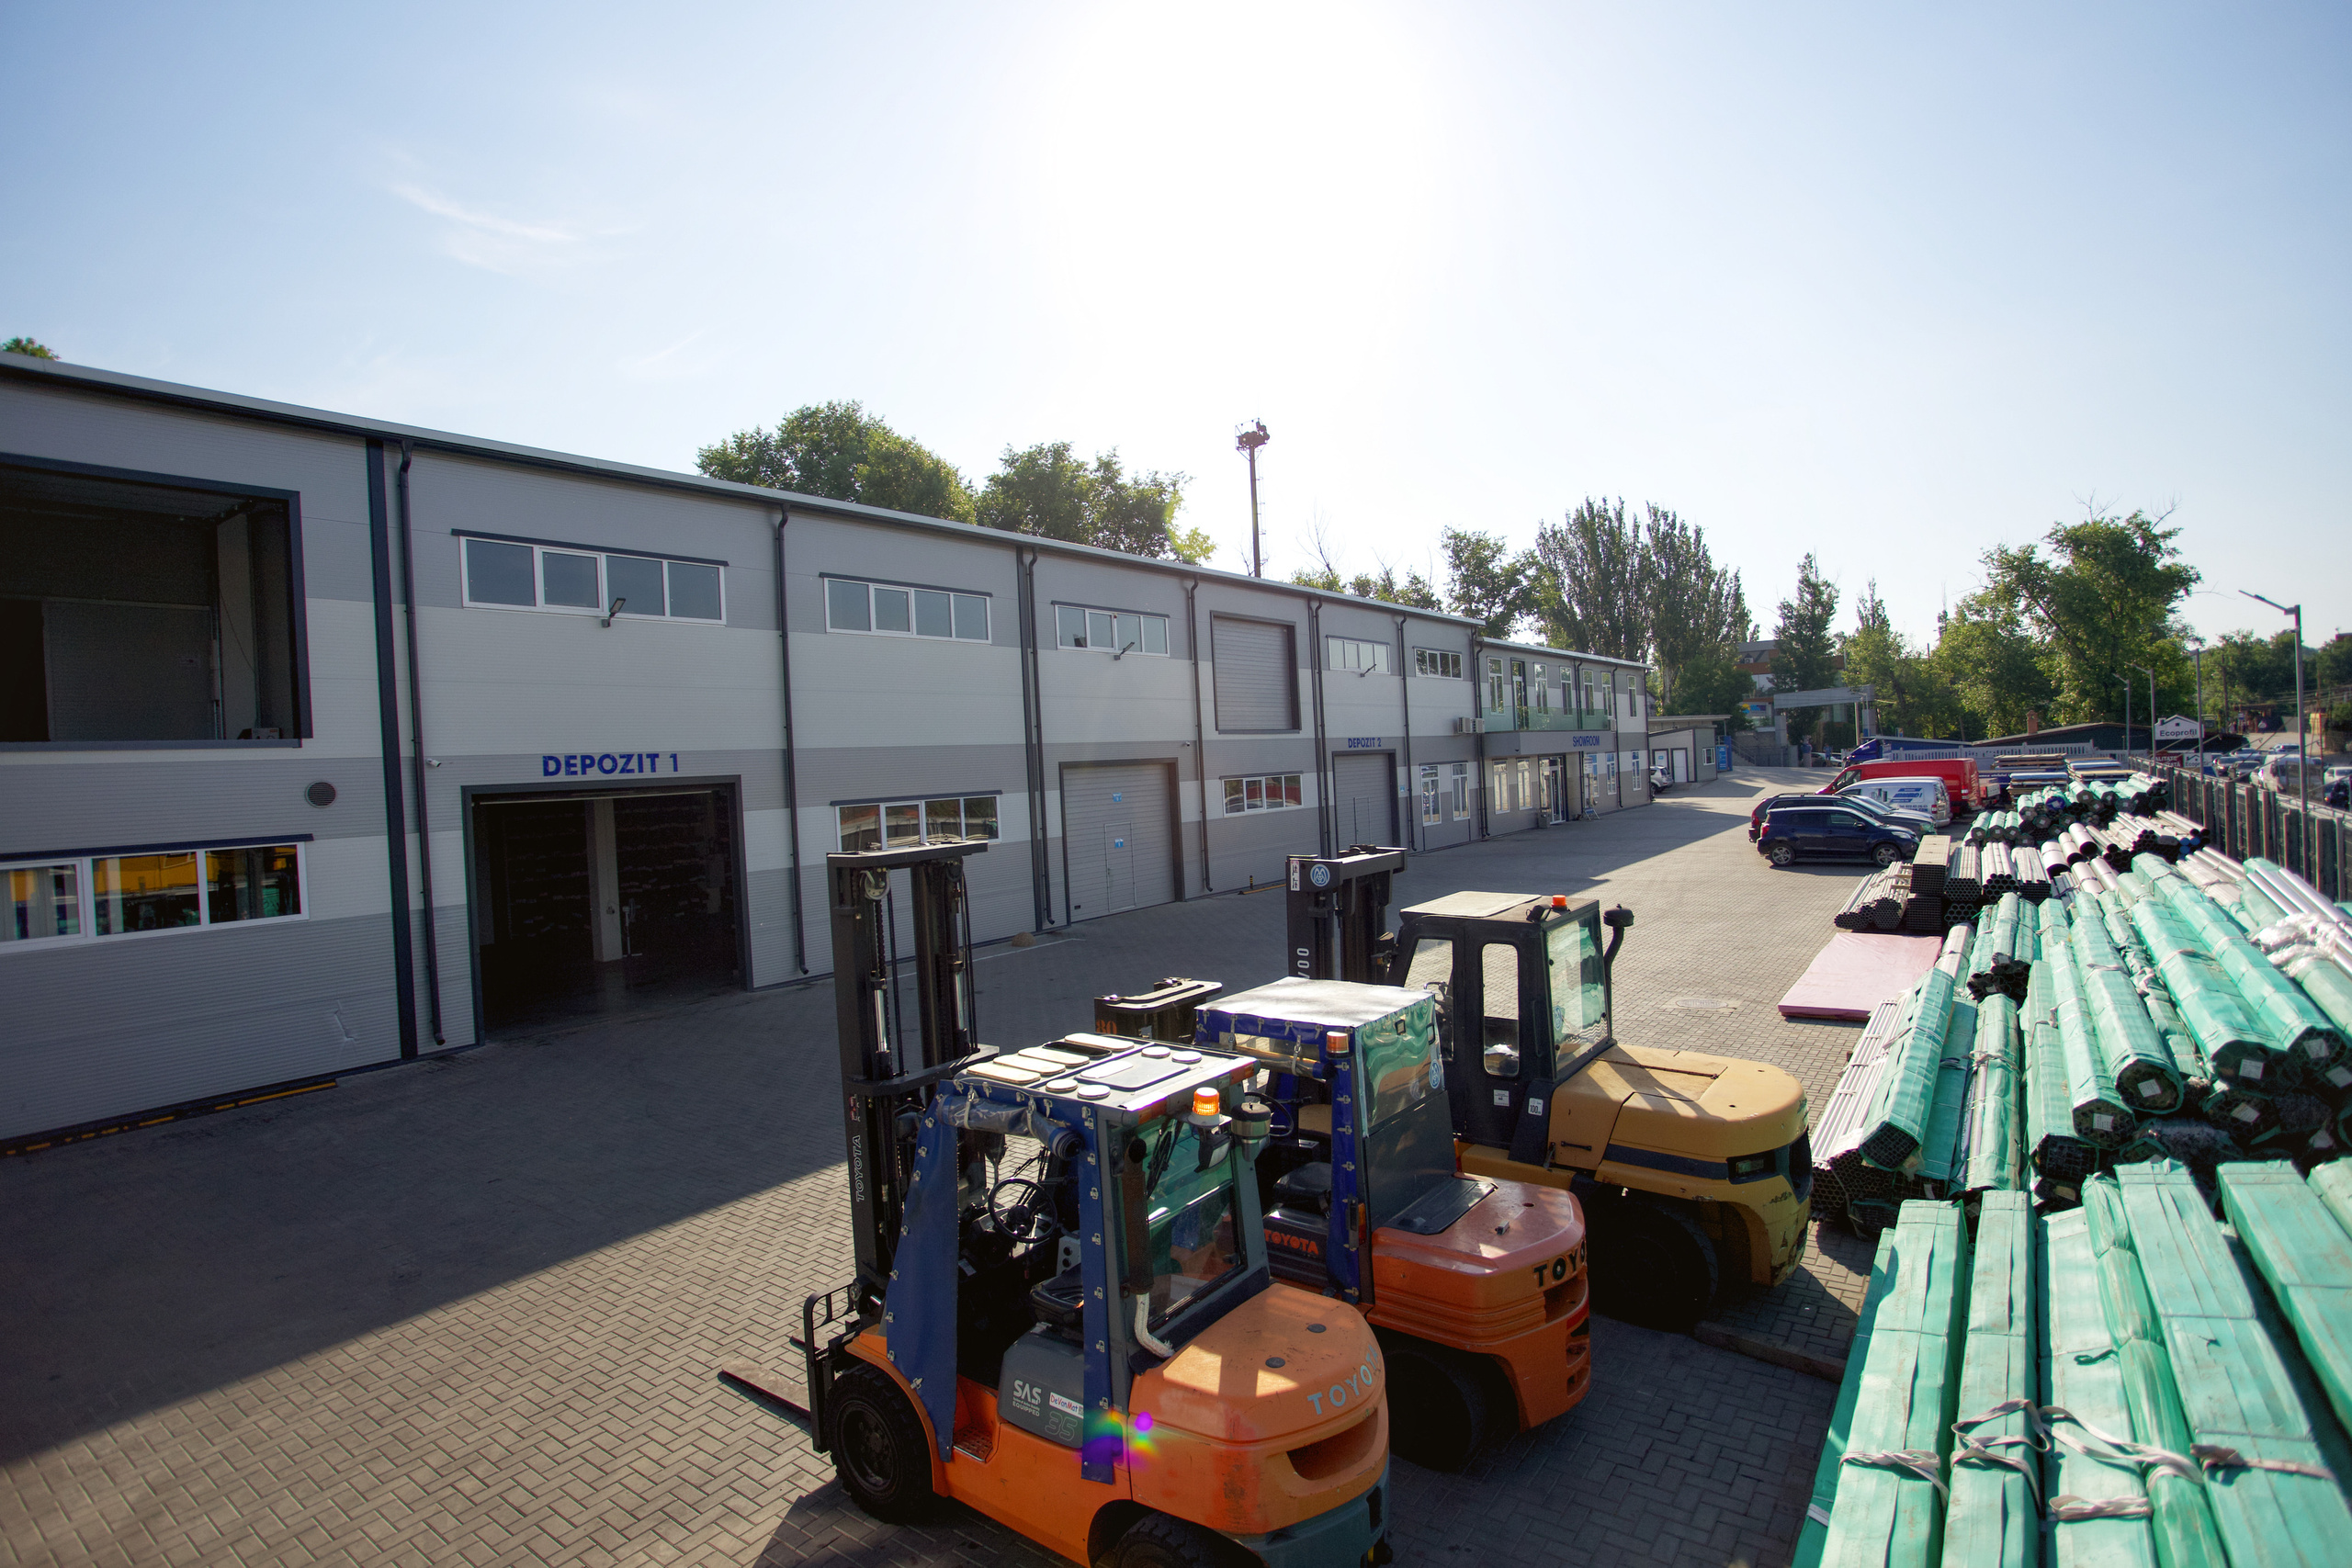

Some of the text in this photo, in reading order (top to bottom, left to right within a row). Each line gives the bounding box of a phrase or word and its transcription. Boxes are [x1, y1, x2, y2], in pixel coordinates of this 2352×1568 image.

[1348, 738, 1382, 748] DEPOZIT 2
[1573, 736, 1600, 747] SHOWROOM
[542, 753, 678, 777] DEPOZIT 1
[1096, 1020, 1117, 1034] 80
[852, 1134, 865, 1202] TOYOTA
[1263, 1228, 1319, 1256] TOYOTA
[1012, 1379, 1042, 1405] SAS
[1012, 1400, 1040, 1417] EQUIPPED
[1050, 1394, 1079, 1413] DeVanMat
[1045, 1411, 1079, 1441] 35
